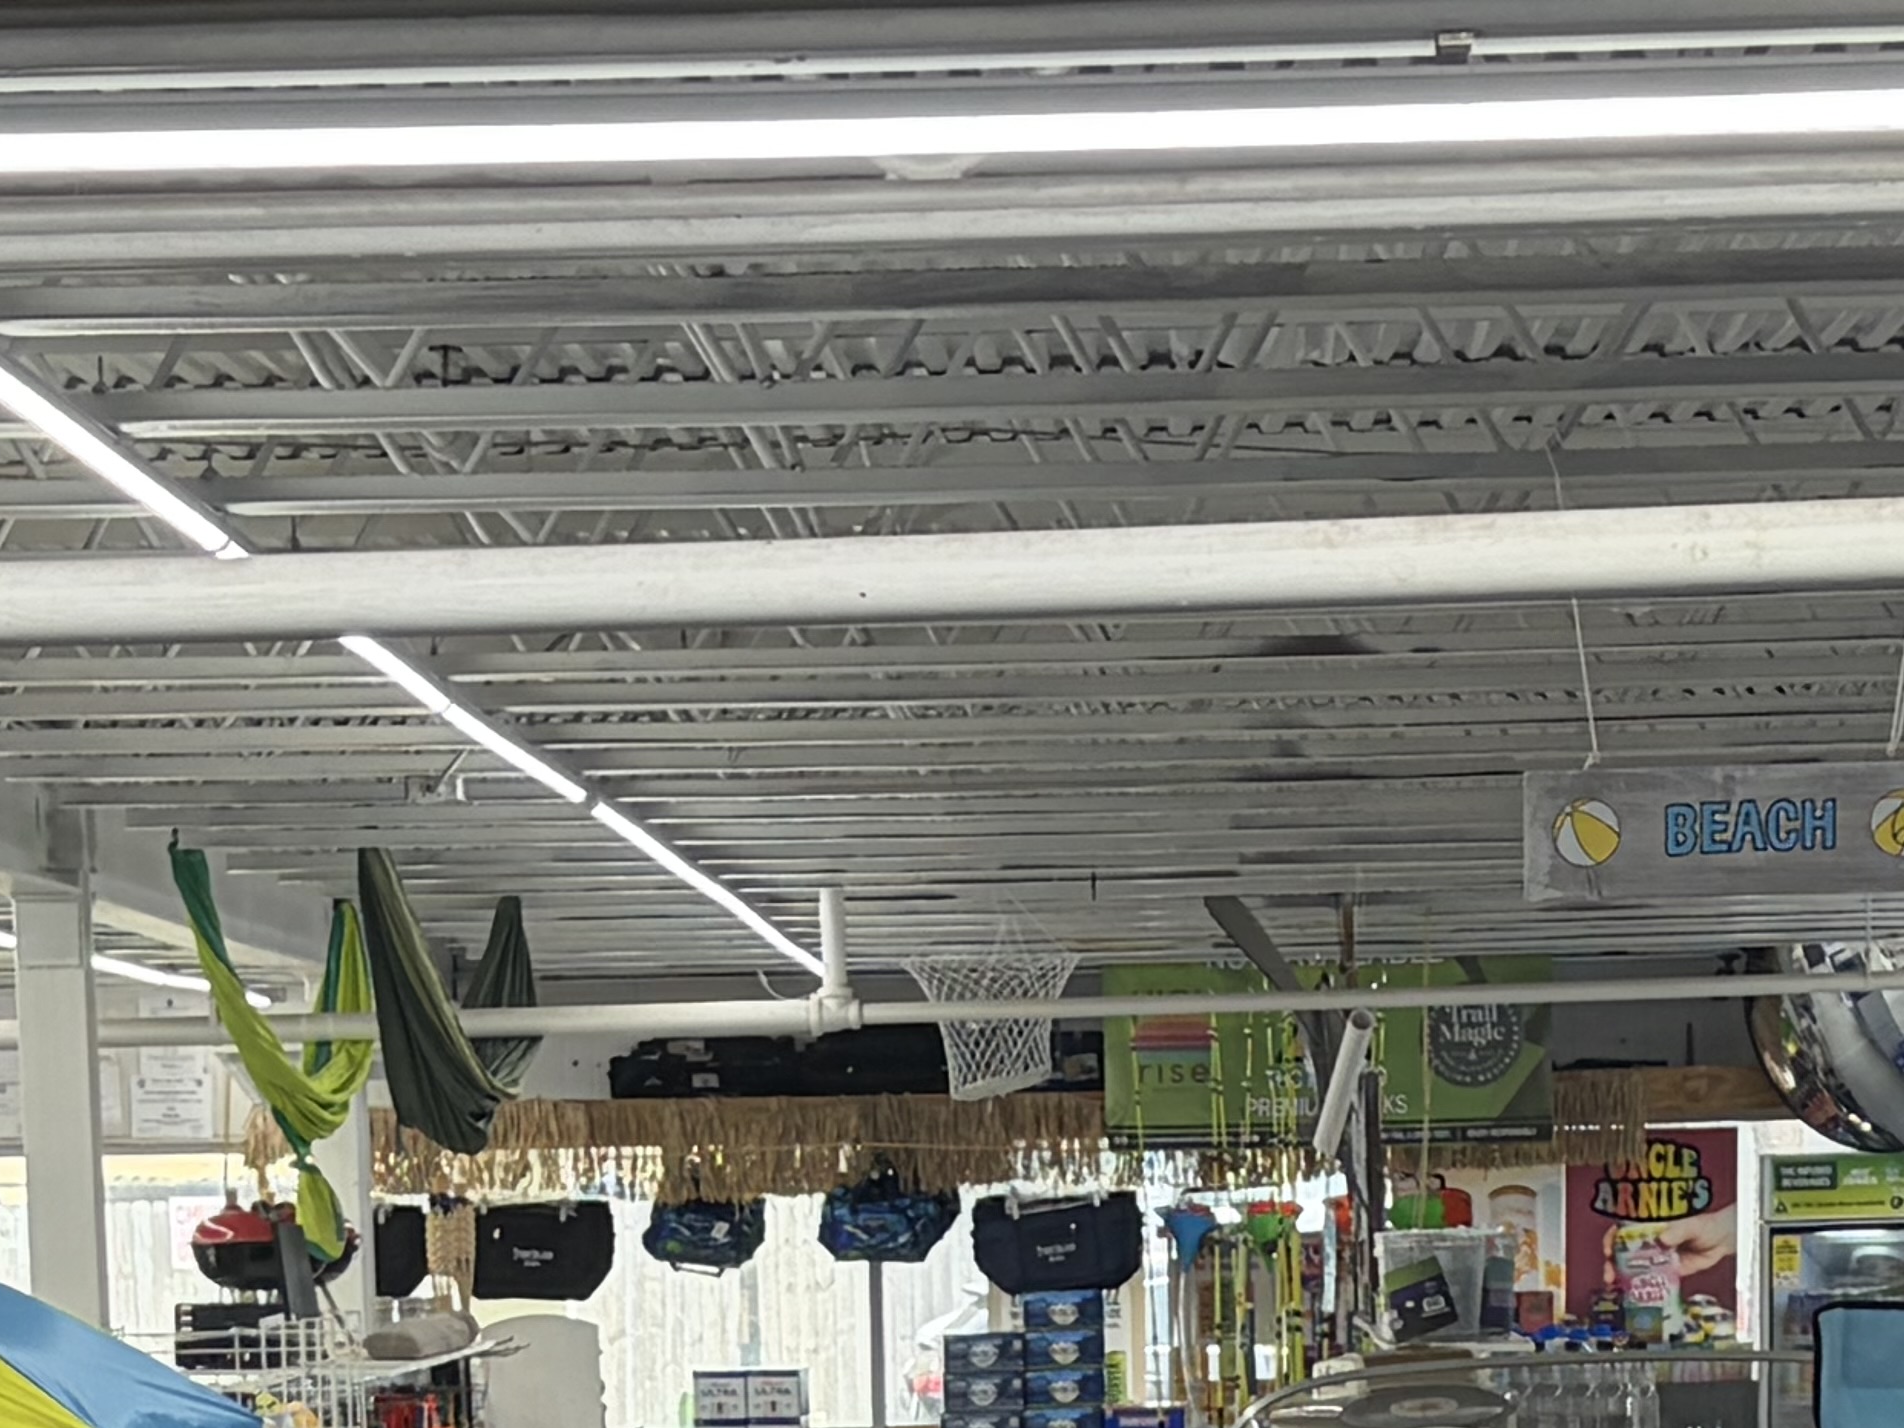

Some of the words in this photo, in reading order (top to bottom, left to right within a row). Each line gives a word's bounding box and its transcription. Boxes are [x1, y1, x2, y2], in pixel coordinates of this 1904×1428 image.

[1664, 797, 1837, 858] BEACH
[1138, 1061, 1211, 1085] rise
[1247, 1095, 1318, 1118] PREMIU
[1594, 1179, 1710, 1219] ARNIE'S
